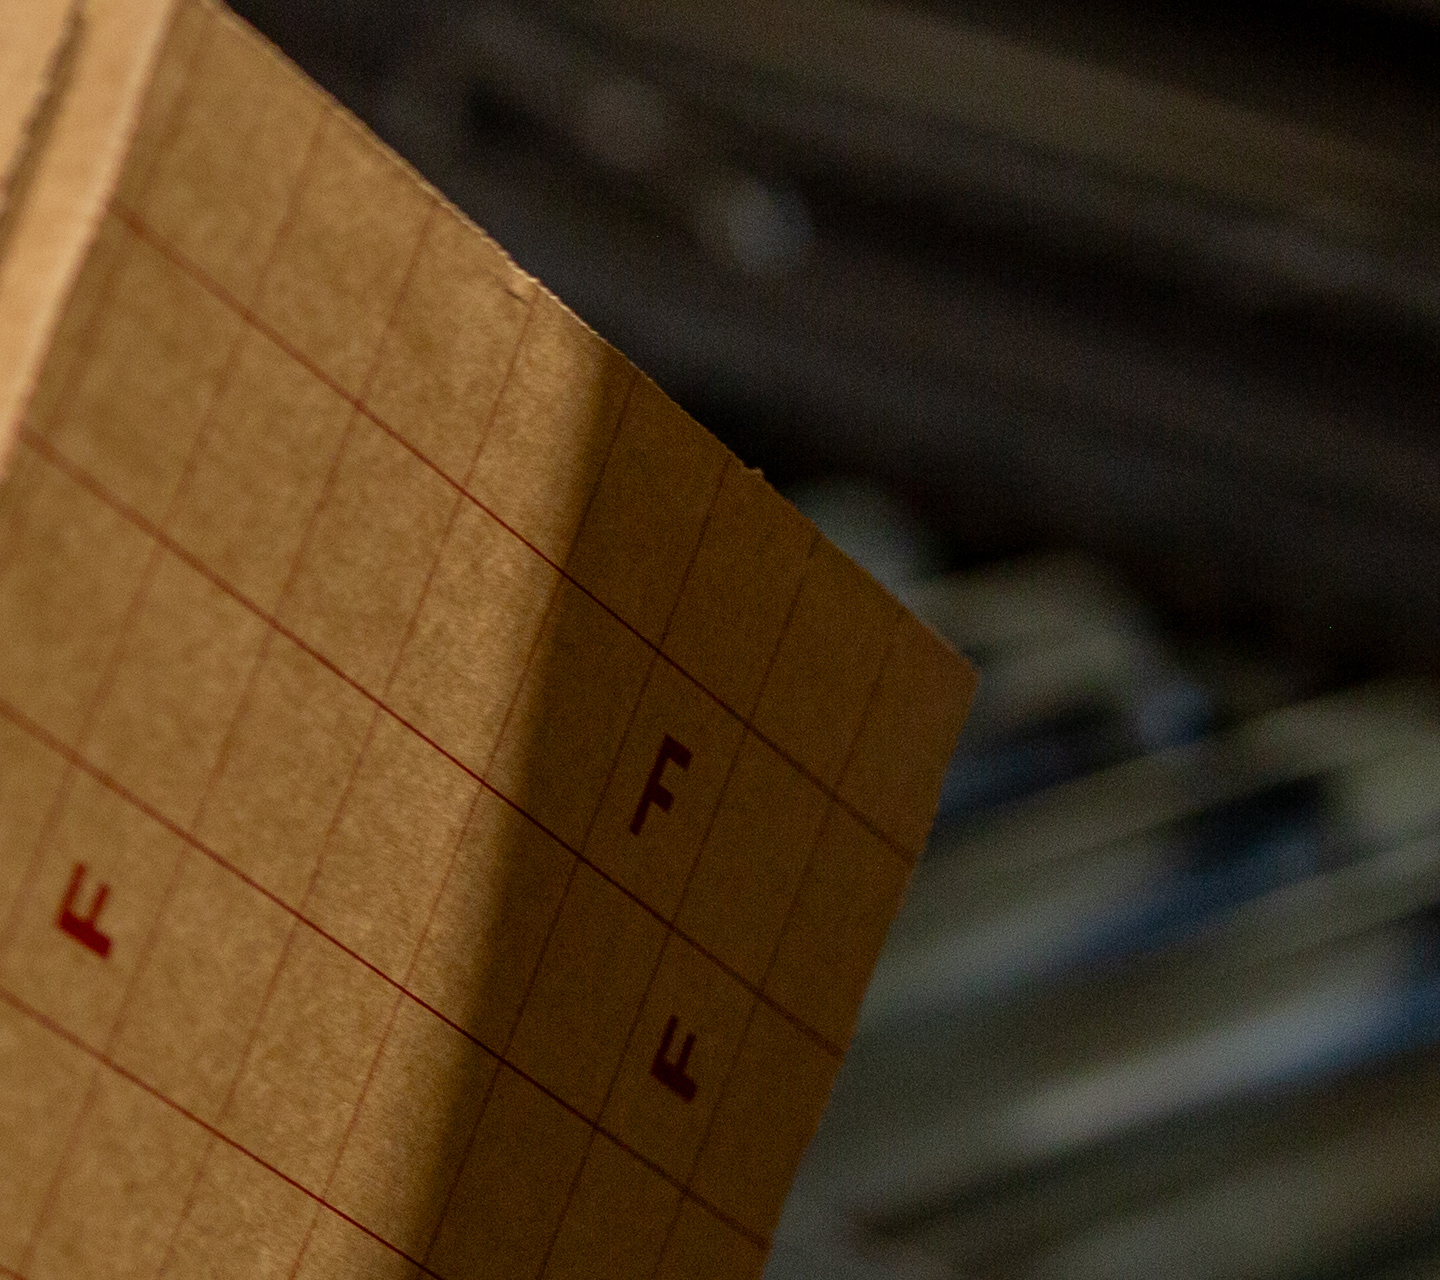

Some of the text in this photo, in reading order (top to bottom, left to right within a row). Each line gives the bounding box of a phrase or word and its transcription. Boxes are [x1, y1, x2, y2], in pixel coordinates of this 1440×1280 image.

[628, 734, 691, 835] F
[56, 863, 113, 957] F
[650, 1015, 697, 1102] F
